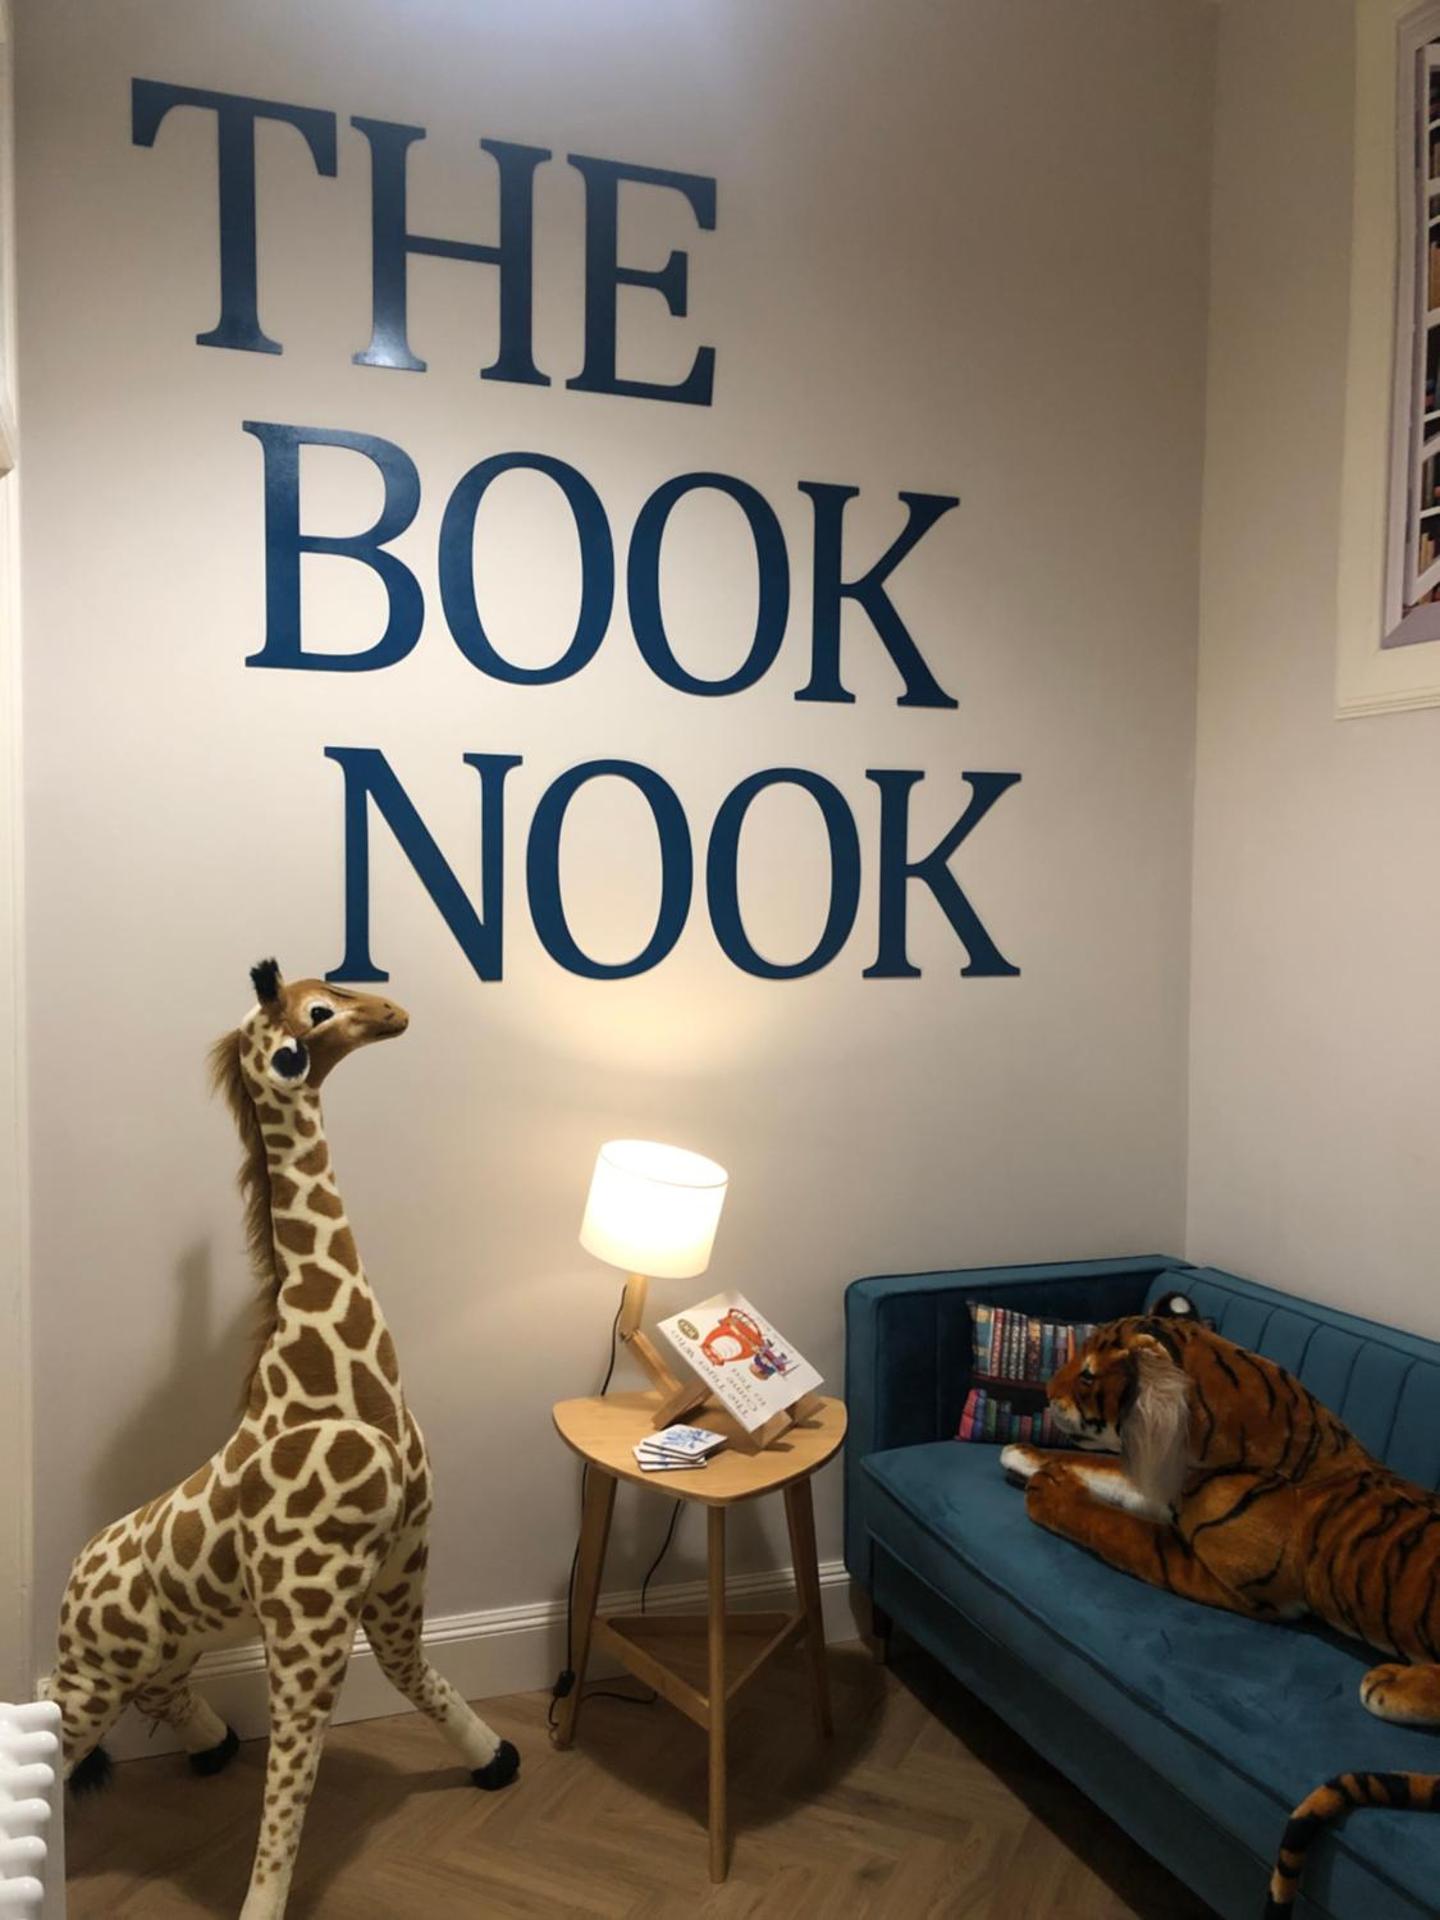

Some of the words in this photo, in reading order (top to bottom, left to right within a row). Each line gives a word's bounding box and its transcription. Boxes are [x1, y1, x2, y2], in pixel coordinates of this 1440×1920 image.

[132, 78, 716, 406] THE
[243, 420, 960, 708] BOOK
[324, 746, 1022, 982] NOOK
